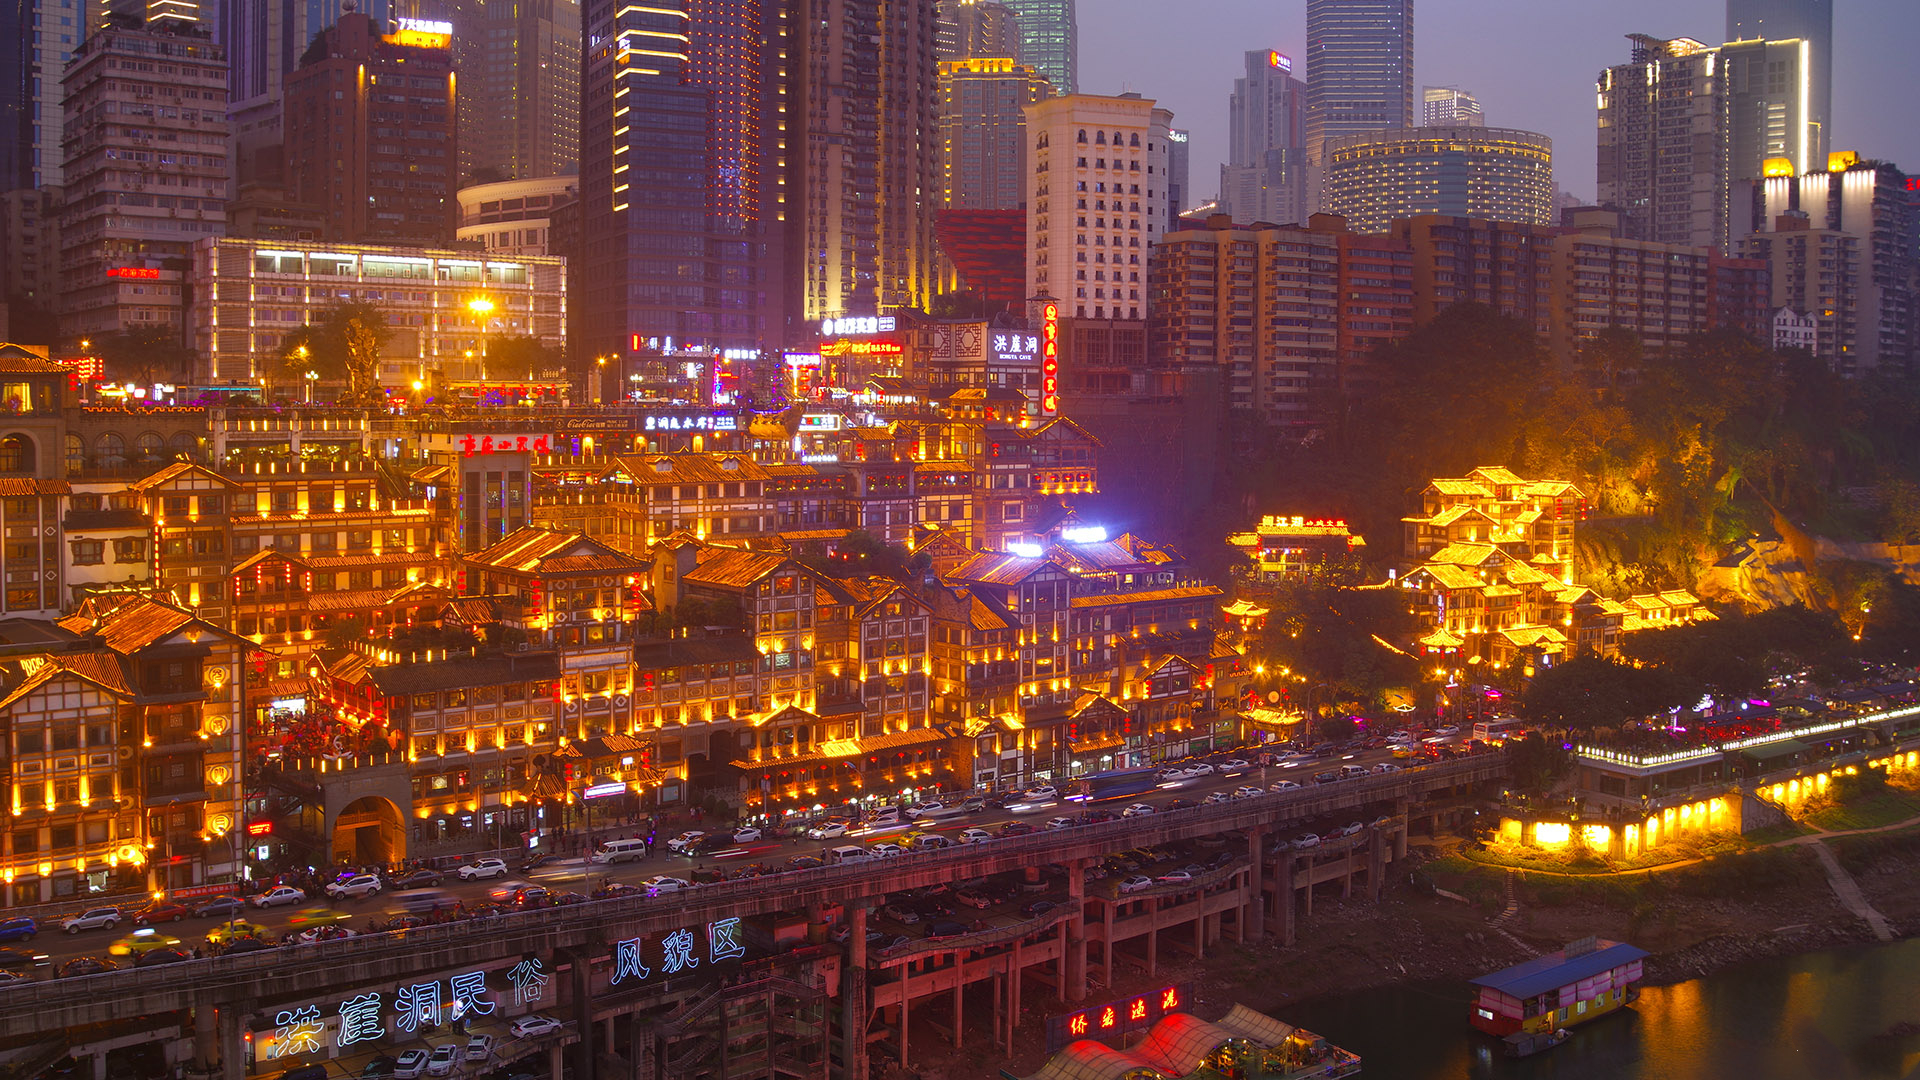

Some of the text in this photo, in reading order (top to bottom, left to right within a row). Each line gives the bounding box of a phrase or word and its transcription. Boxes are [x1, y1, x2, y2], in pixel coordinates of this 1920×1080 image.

[993, 333, 1038, 354] 洪崖洞
[275, 917, 747, 1058] 洪崖洞民俗 风貌区
